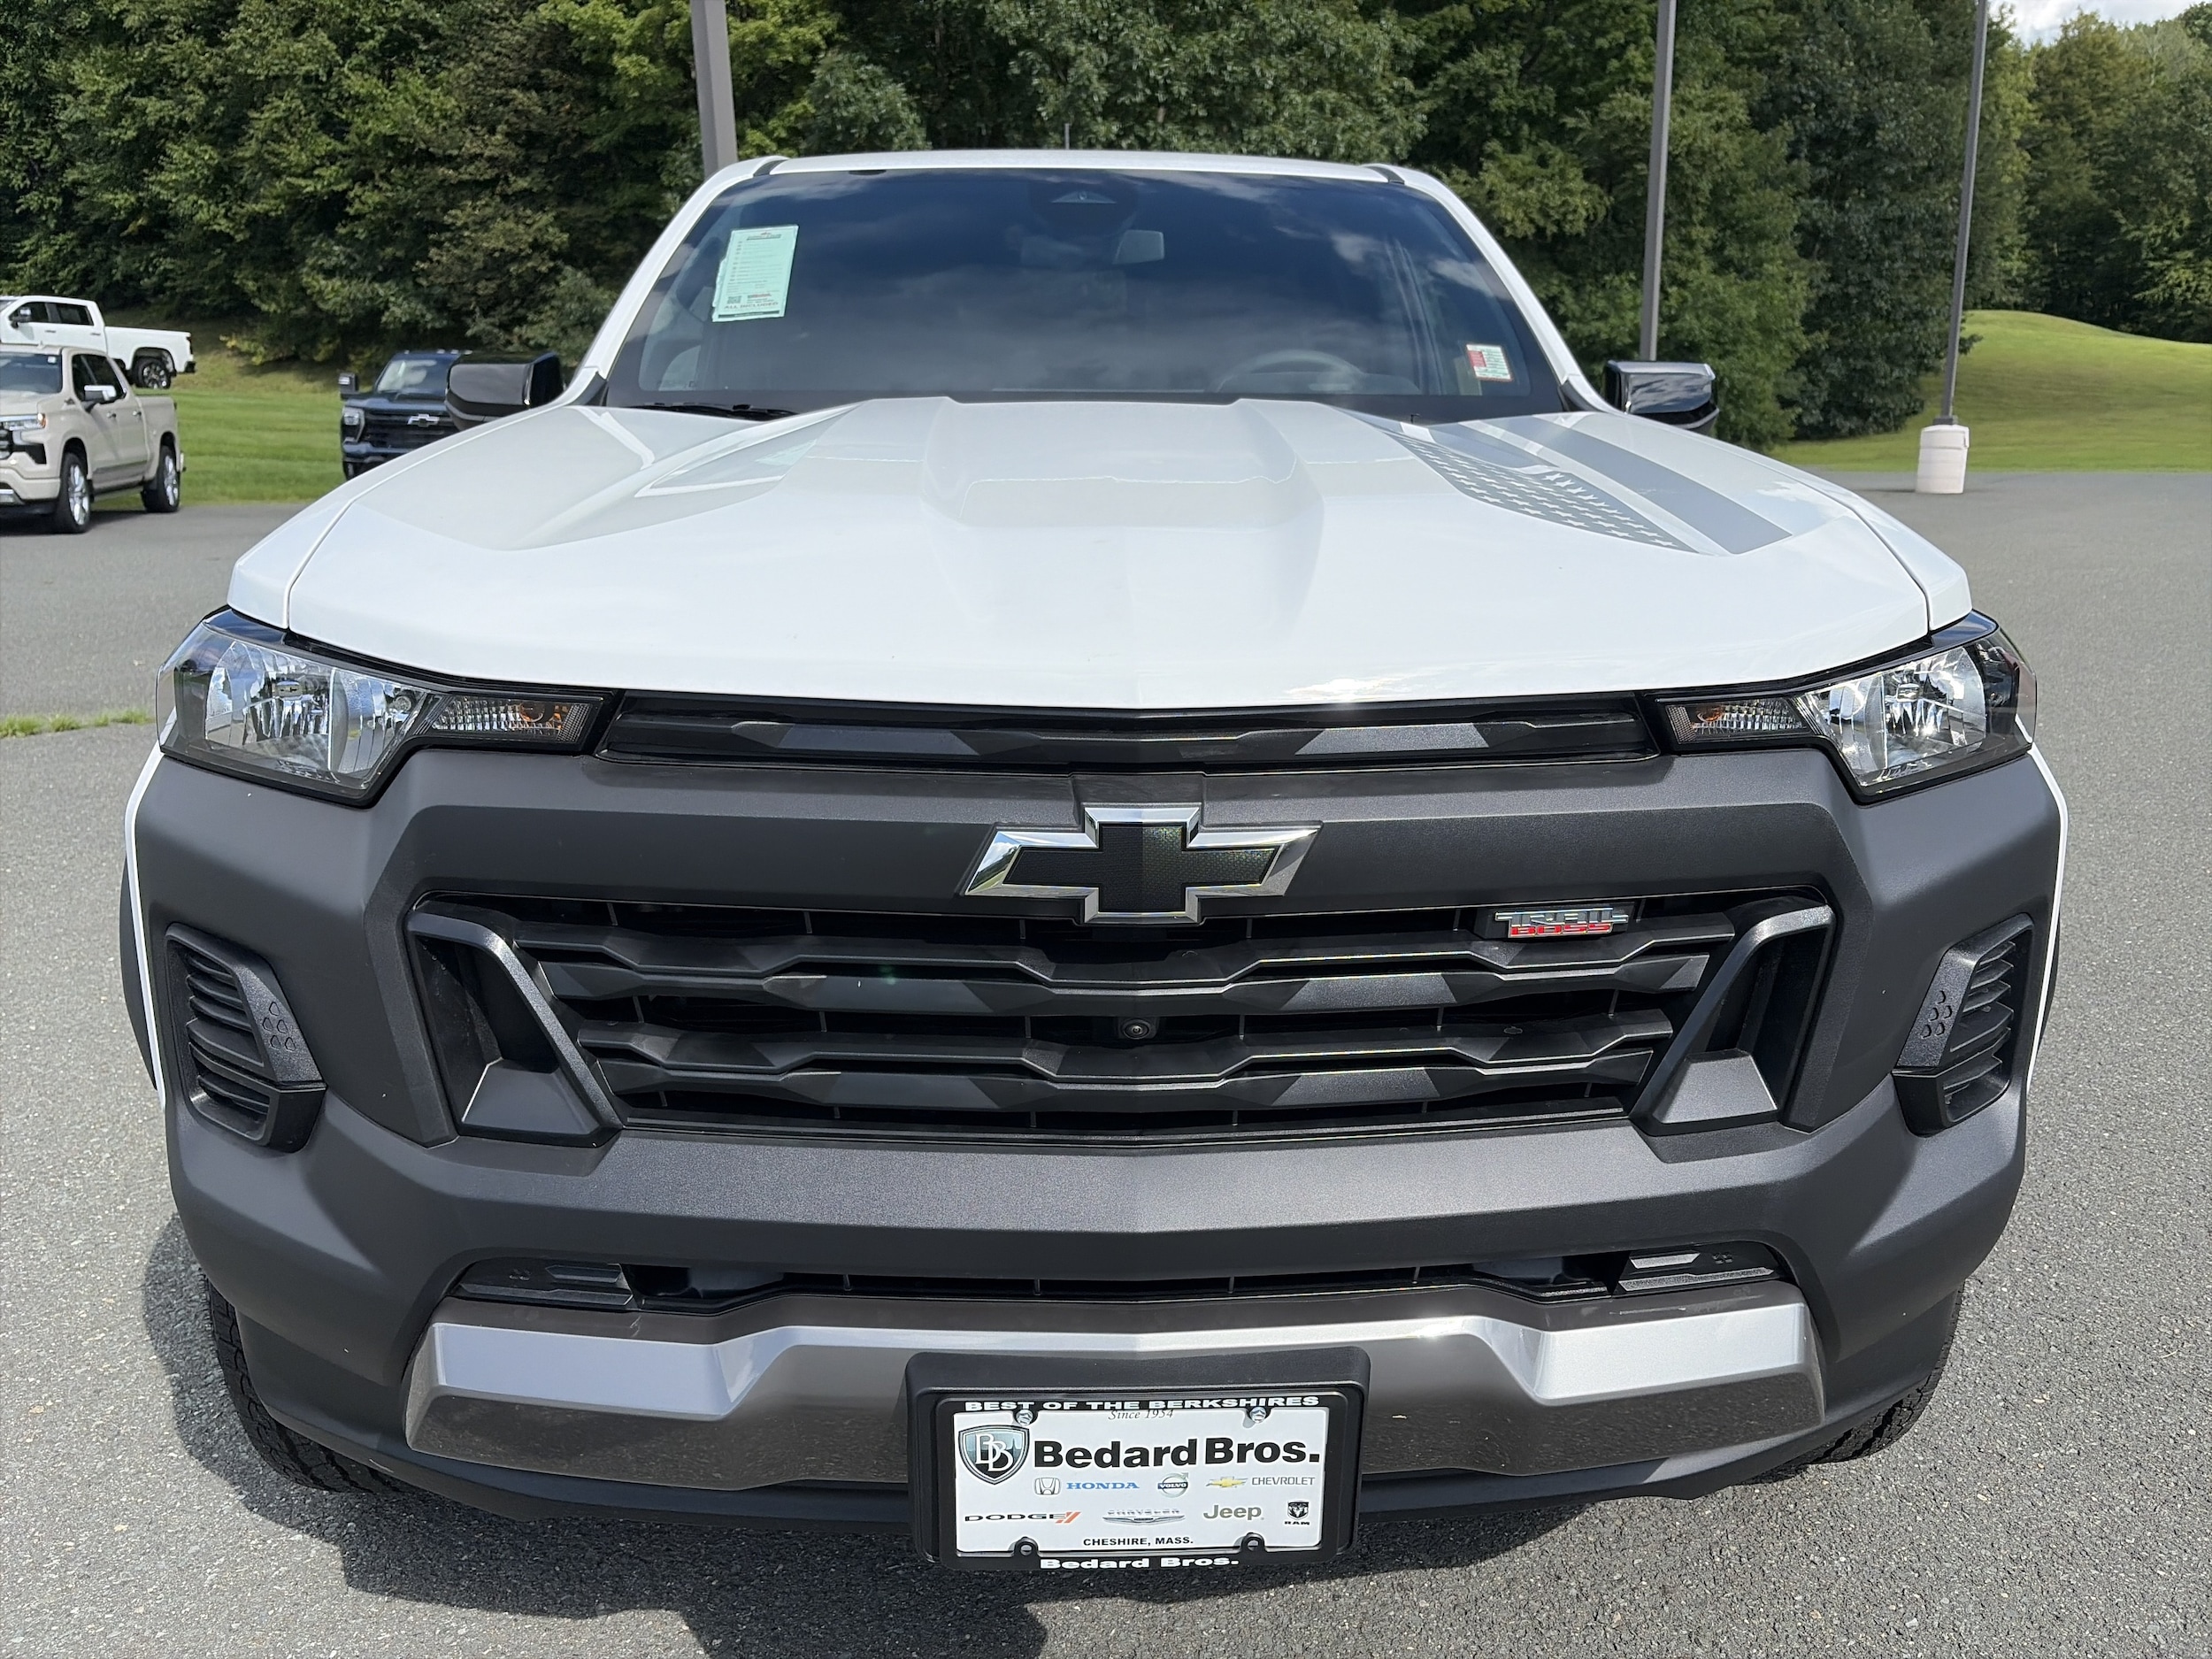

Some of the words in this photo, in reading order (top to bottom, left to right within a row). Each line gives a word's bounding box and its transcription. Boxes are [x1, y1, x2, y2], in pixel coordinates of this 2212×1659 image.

[1509, 922, 1614, 937] BOSS
[964, 1401, 1035, 1411] BEST
[1042, 1401, 1078, 1410] OF
[1086, 1400, 1140, 1410] THE
[1148, 1395, 1319, 1409] BERKSHIRES
[1108, 1409, 1141, 1421] Since
[1144, 1408, 1174, 1419] 1954
[1033, 1438, 1198, 1469] Bedard
[1205, 1437, 1320, 1464] Bros.
[1158, 1481, 1188, 1490] VOLVO
[1251, 1476, 1316, 1486] CHEVROLET
[964, 1513, 1067, 1522] DODGE
[1203, 1504, 1263, 1521] Jeep
[1083, 1537, 1151, 1547] CHESHIRE,
[1040, 1558, 1150, 1570] Bedard
[1160, 1557, 1240, 1569] Bros.
